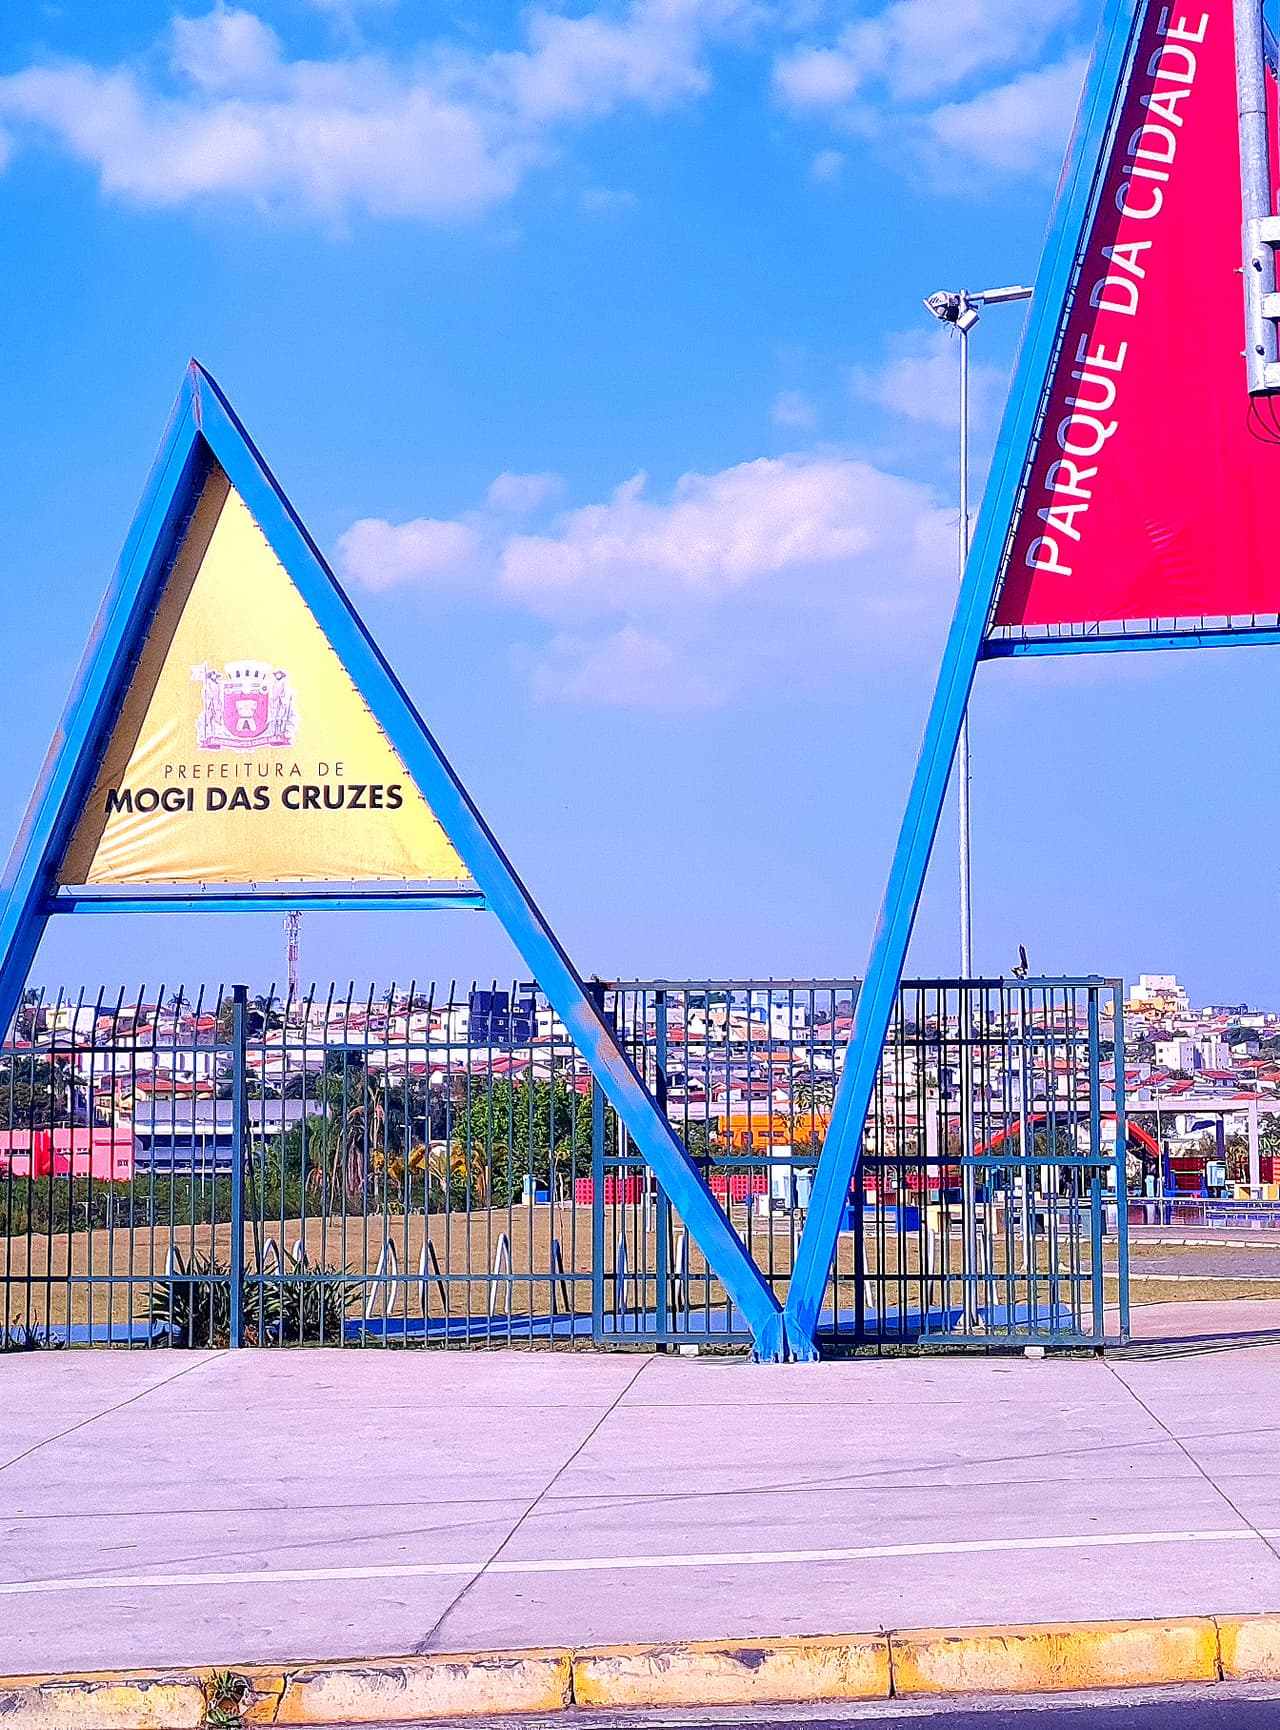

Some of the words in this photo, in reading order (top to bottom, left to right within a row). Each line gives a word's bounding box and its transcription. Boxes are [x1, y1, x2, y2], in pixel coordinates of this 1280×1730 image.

[1115, 6, 1209, 219] CIDADE
[1089, 241, 1152, 315] DA
[1025, 333, 1128, 576] PARQUE
[104, 787, 194, 814] MOGI
[206, 785, 271, 811] DAS
[281, 784, 404, 810] CRUZES
[164, 762, 302, 779] PREFEITURA
[318, 761, 345, 777] DE
